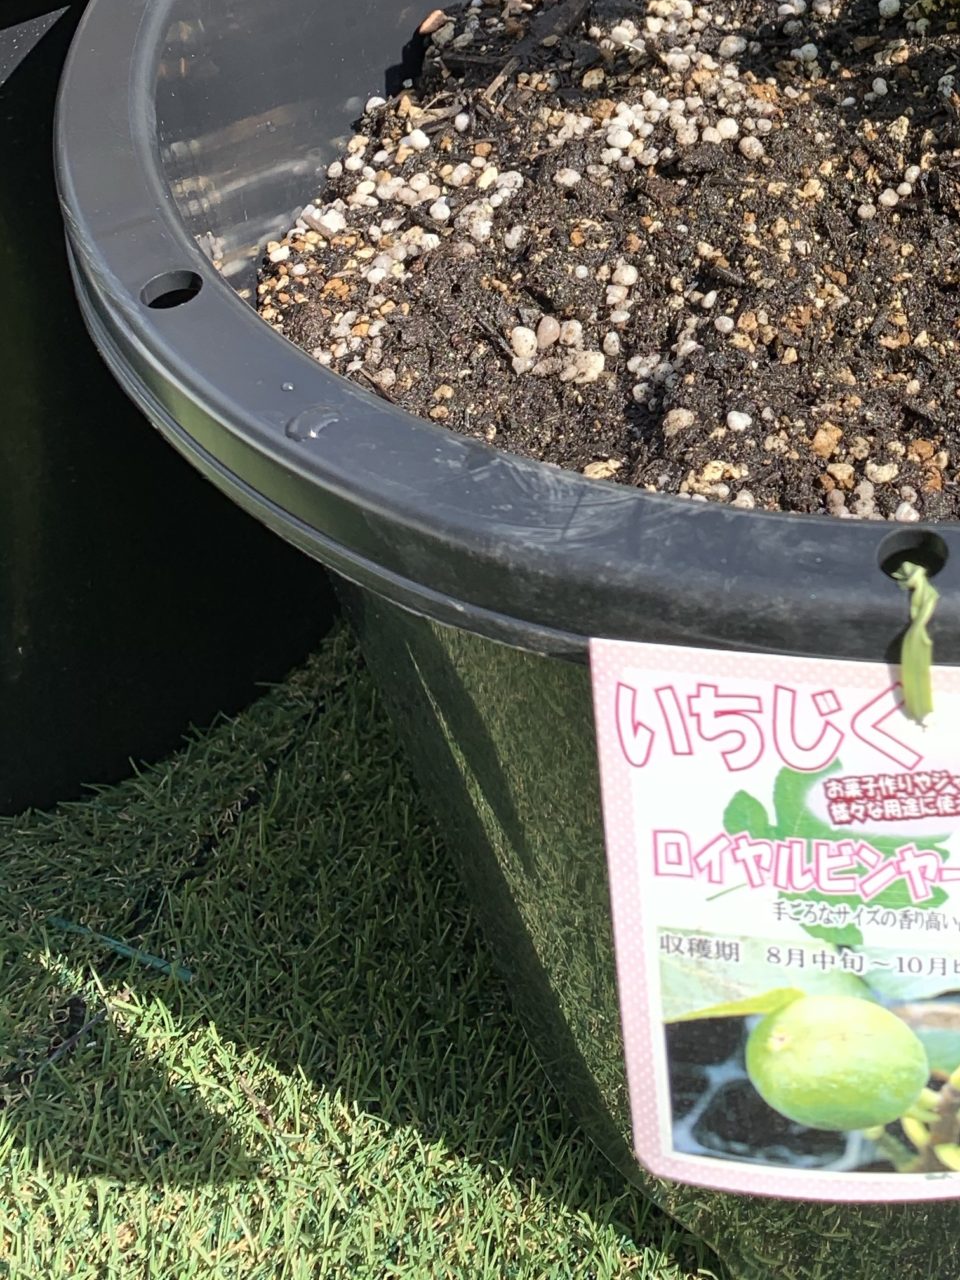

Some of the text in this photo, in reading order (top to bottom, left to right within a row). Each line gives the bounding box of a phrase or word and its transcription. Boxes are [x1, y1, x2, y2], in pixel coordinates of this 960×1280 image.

[614, 681, 925, 772] いちじく
[659, 933, 741, 963] 収穫期
